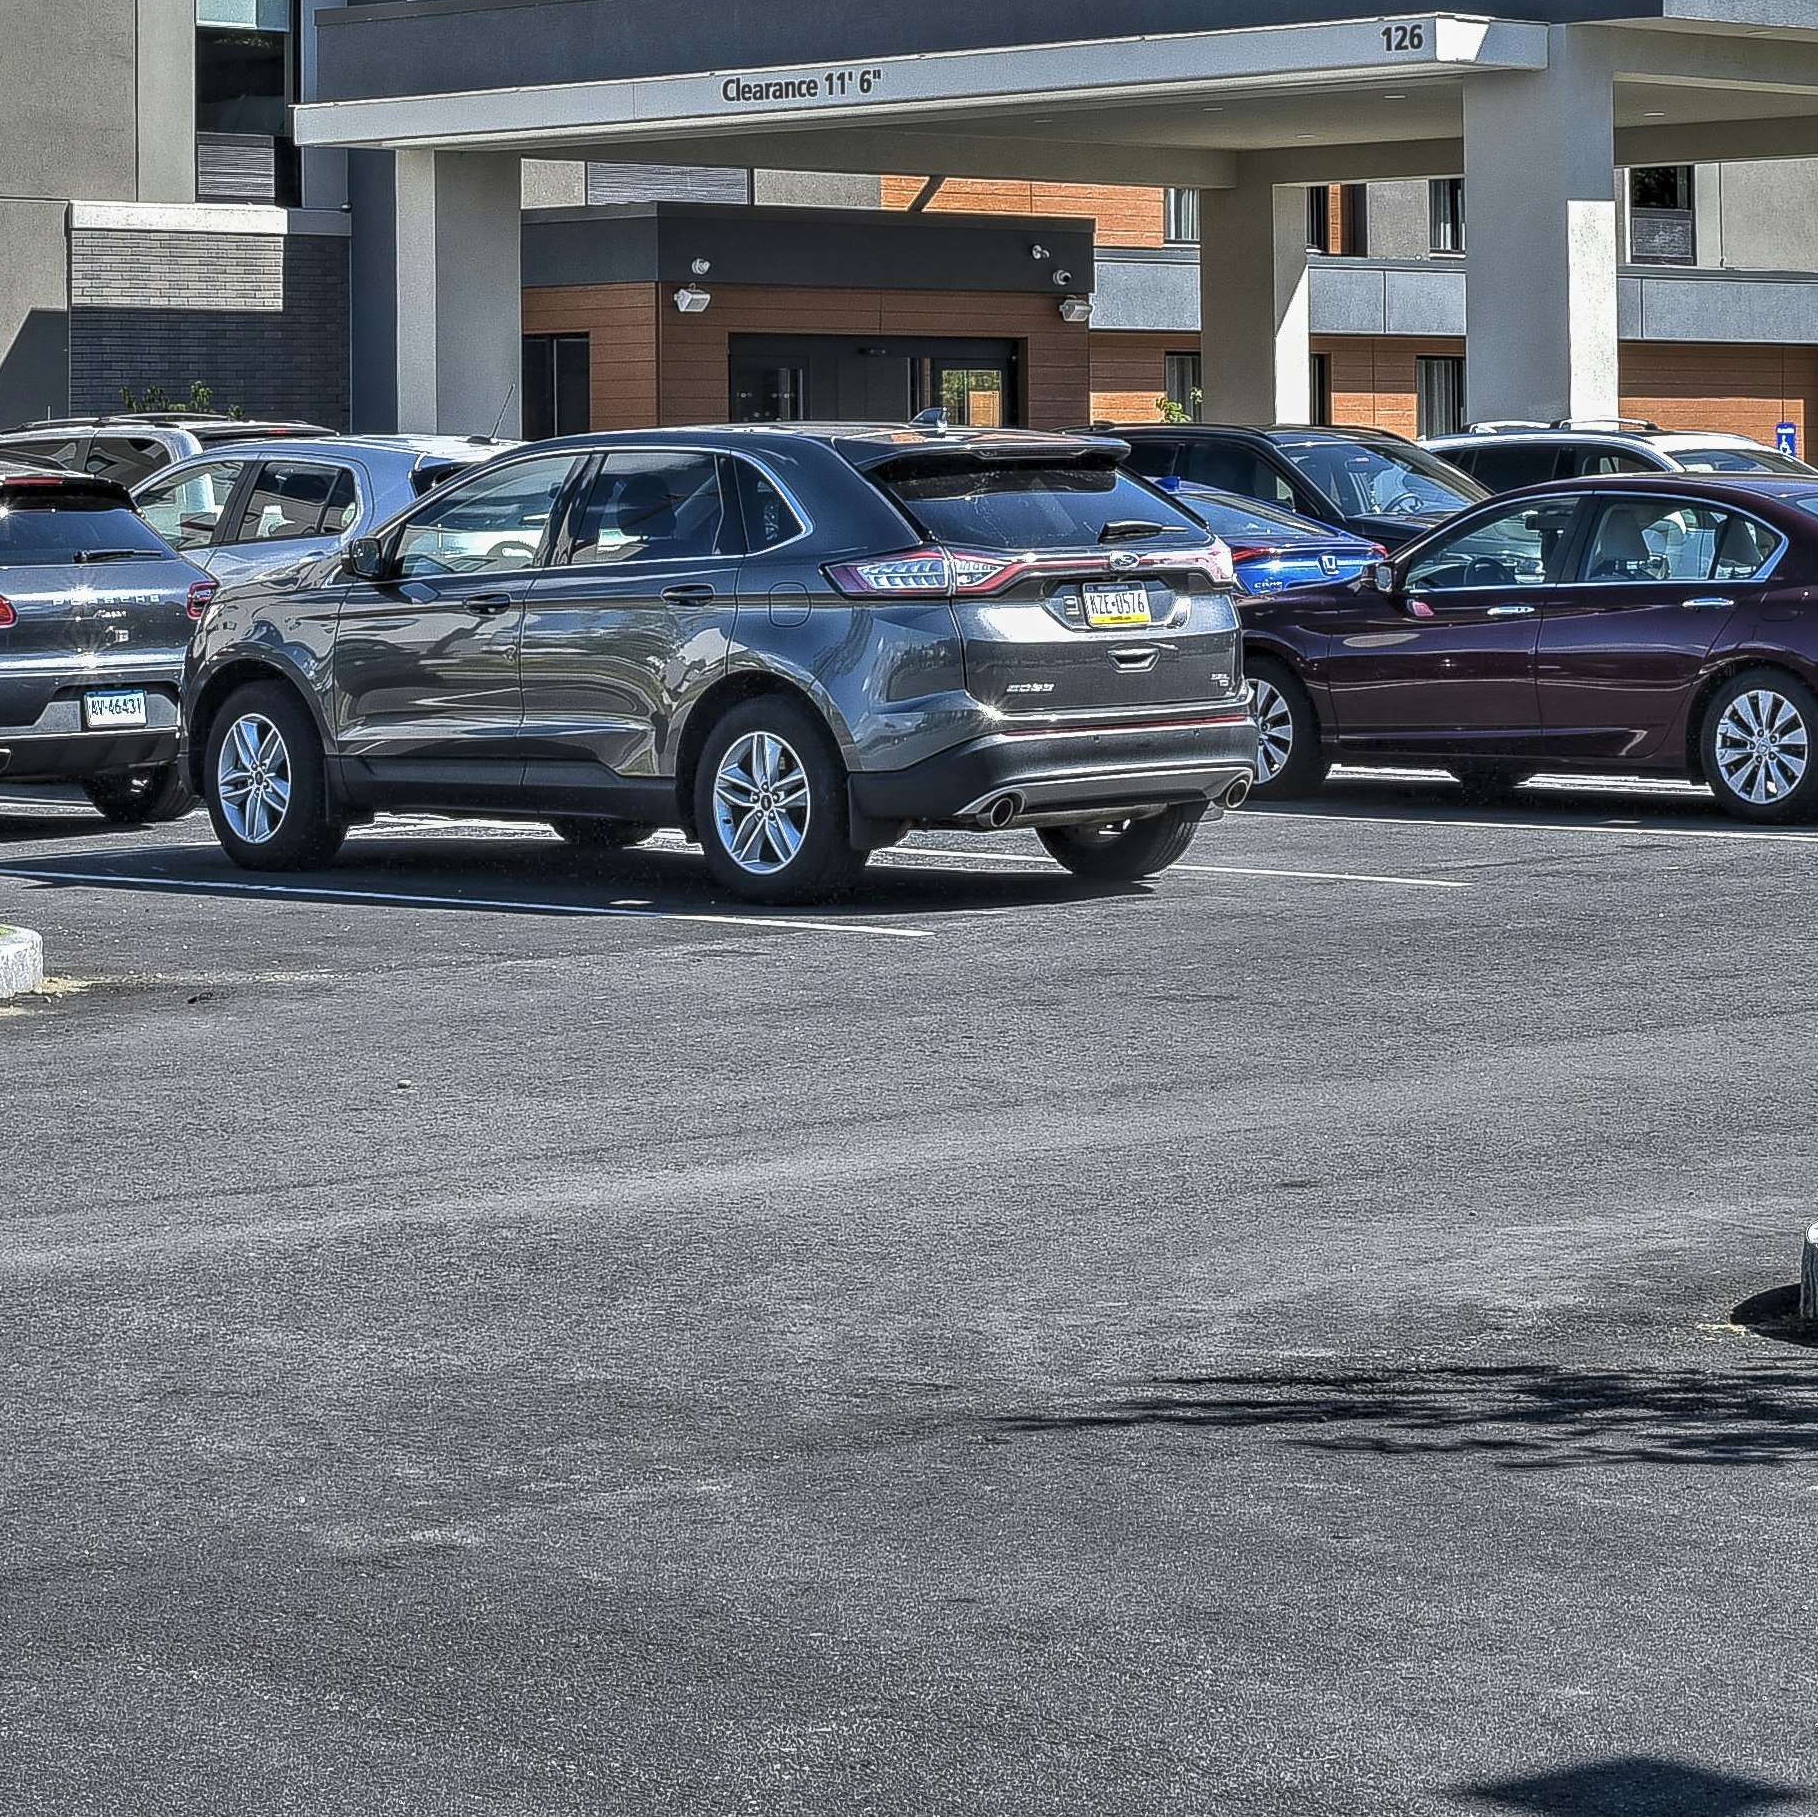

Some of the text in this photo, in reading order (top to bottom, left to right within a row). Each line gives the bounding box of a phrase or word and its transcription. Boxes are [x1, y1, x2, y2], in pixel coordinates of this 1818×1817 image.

[1381, 24, 1424, 52] 126
[722, 68, 882, 102] Clearance 11' 6"
